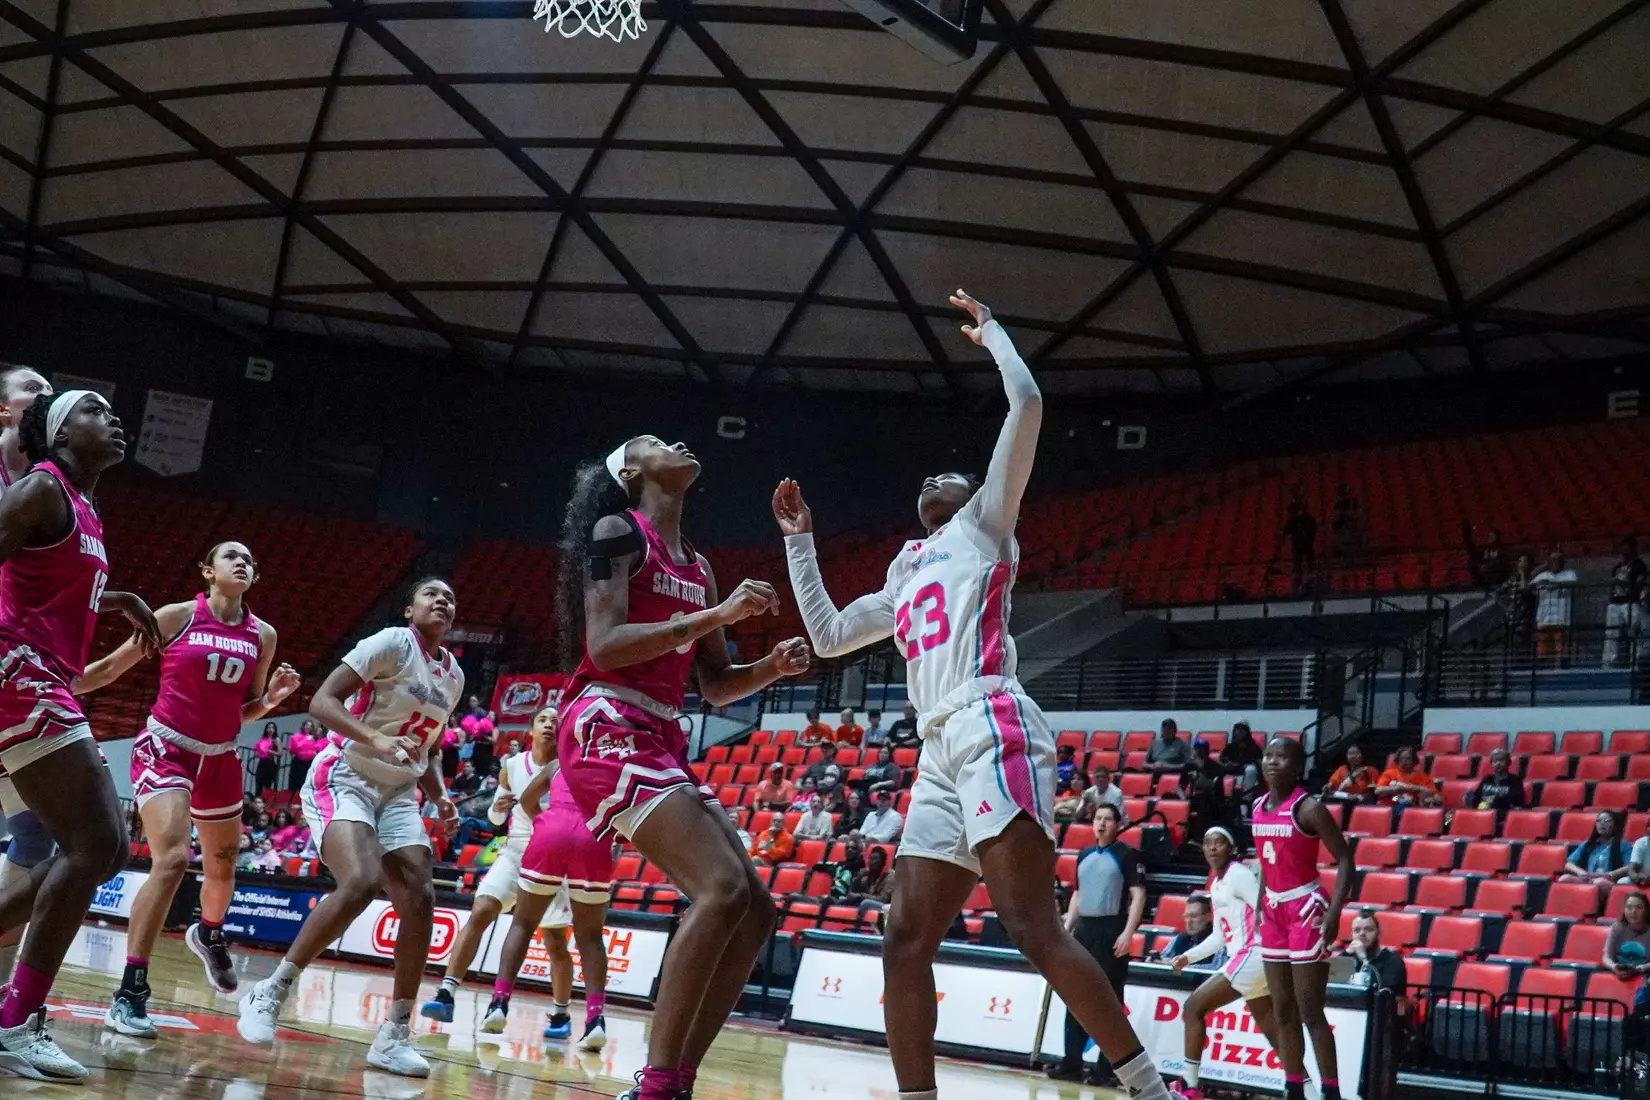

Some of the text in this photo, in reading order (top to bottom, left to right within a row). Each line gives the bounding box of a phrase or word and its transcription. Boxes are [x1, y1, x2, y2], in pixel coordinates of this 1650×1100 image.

[246, 357, 274, 382] B
[1607, 388, 1640, 418] E
[717, 416, 746, 439] C
[1118, 426, 1147, 449] D
[653, 572, 680, 598] SAM
[896, 581, 951, 660] 23
[188, 632, 214, 647] SAM
[206, 653, 245, 684] 10
[1263, 841, 1276, 865] 4
[92, 890, 124, 908] LIGHT
[233, 891, 245, 902] The
[381, 917, 449, 947] HB
